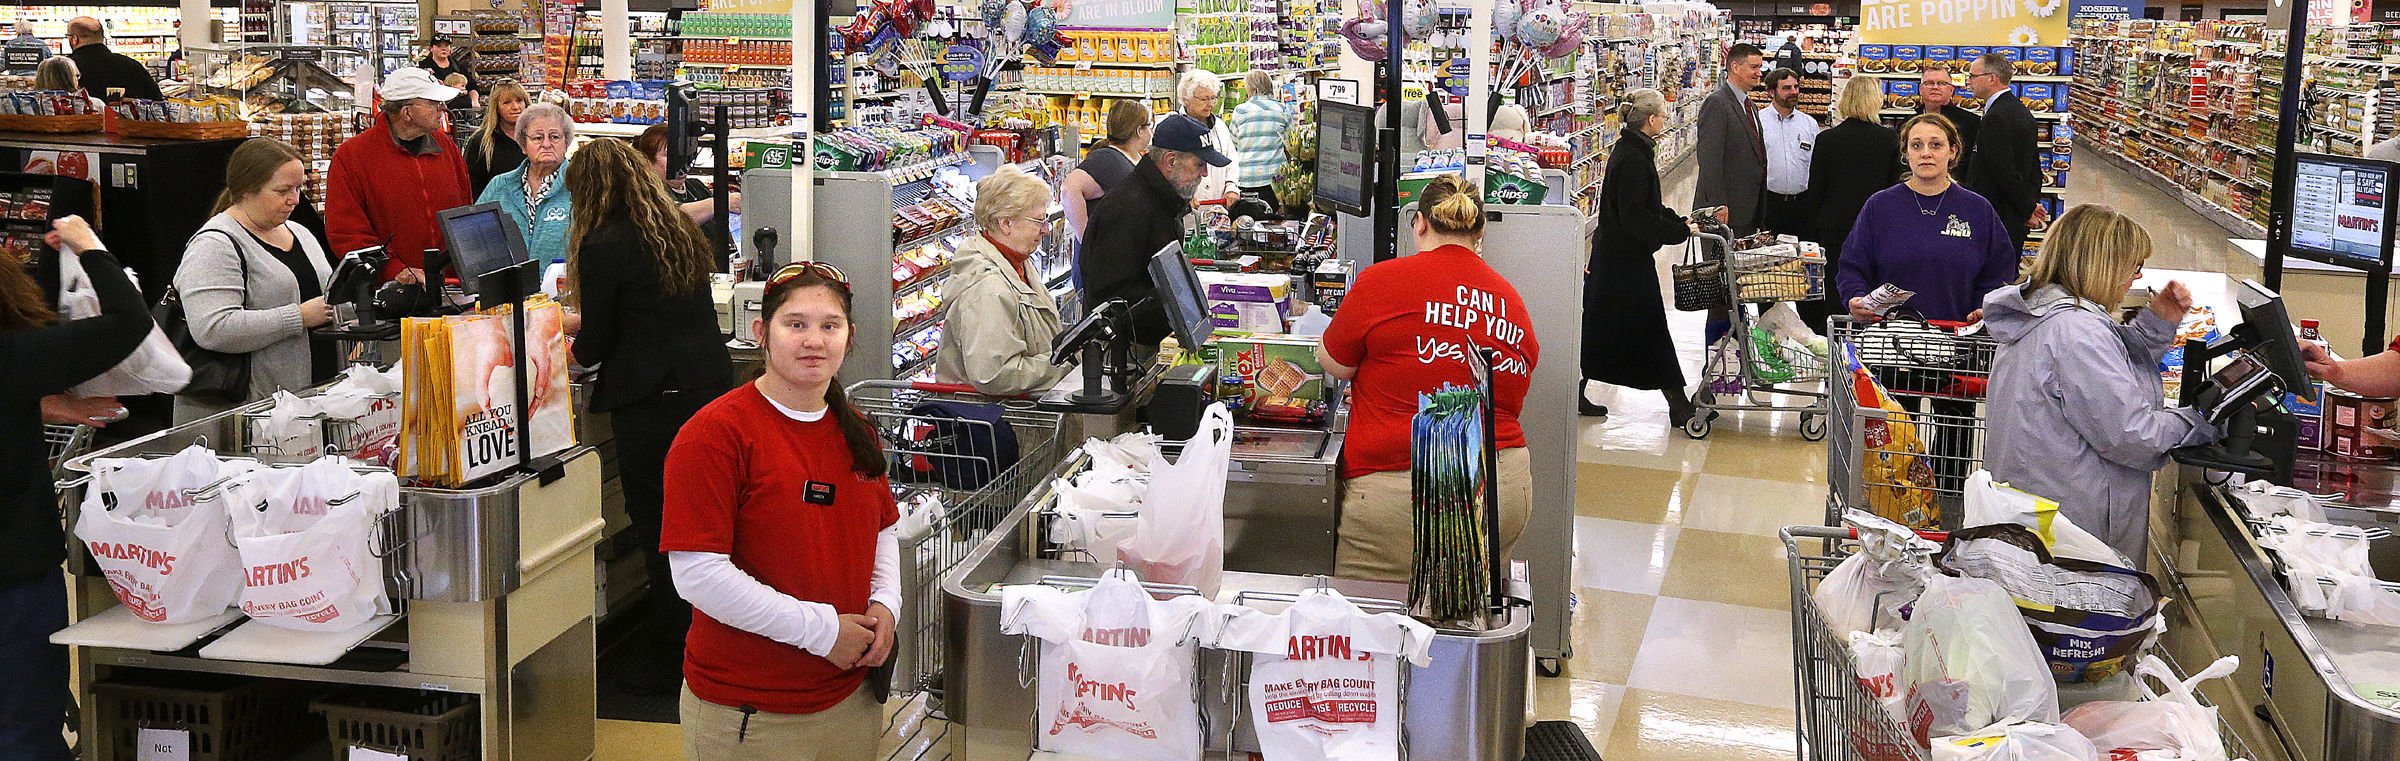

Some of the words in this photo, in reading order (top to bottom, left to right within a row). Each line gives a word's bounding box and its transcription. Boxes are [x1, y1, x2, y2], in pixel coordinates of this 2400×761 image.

[1078, 4, 1100, 20] ARE
[1105, 2, 1118, 17] IN
[1122, 0, 1164, 16] BLOOM
[1866, 3, 1912, 31] ARE
[1404, 88, 1423, 98] free
[766, 156, 784, 164] tac
[770, 150, 785, 158] tic
[2362, 178, 2376, 188] SAVE
[1490, 188, 1529, 201] eclipse
[2338, 214, 2379, 233] MARTIN'S
[1940, 228, 1970, 238] JMU
[1220, 286, 1236, 294] Viva
[1456, 285, 1494, 313] CAN
[1500, 298, 1506, 318] I
[1424, 301, 1478, 330] HELP
[1484, 314, 1524, 350] YOU?
[465, 412, 486, 426] ALL
[489, 404, 512, 418] YOU
[465, 418, 506, 437] KNEAD
[467, 427, 516, 468] LOVE
[91, 541, 176, 576] MARTIN'S
[278, 601, 298, 610] BAG
[2070, 638, 2092, 650] MIX
[2052, 646, 2105, 659] REFRESH!
[1264, 682, 1293, 693] MAKE
[1320, 678, 1340, 690] BAG
[1342, 678, 1376, 690] COUNT
[1266, 700, 1302, 712] REDUCE
[1338, 703, 1376, 712] RECYCLE
[154, 743, 172, 754] Not
